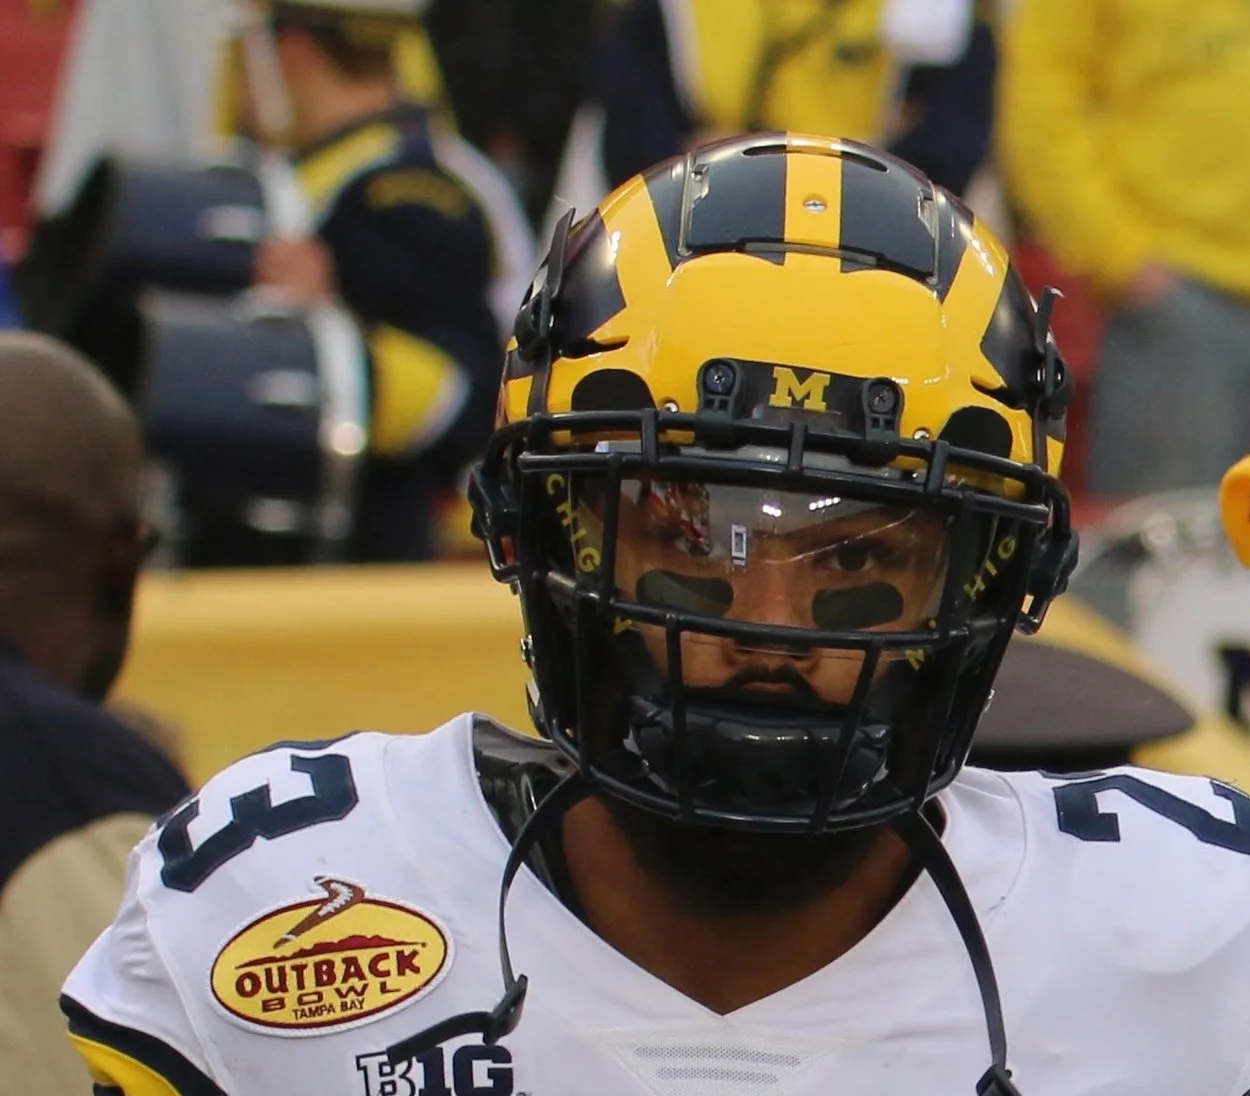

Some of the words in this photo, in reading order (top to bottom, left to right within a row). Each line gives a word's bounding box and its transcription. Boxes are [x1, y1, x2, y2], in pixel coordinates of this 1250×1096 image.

[768, 366, 831, 412] M
[157, 732, 359, 893] 3
[235, 950, 421, 998] OUTBACK
[261, 980, 401, 1013] BOWL
[292, 1004, 336, 1021] TAMPA
[340, 998, 366, 1012] BAY
